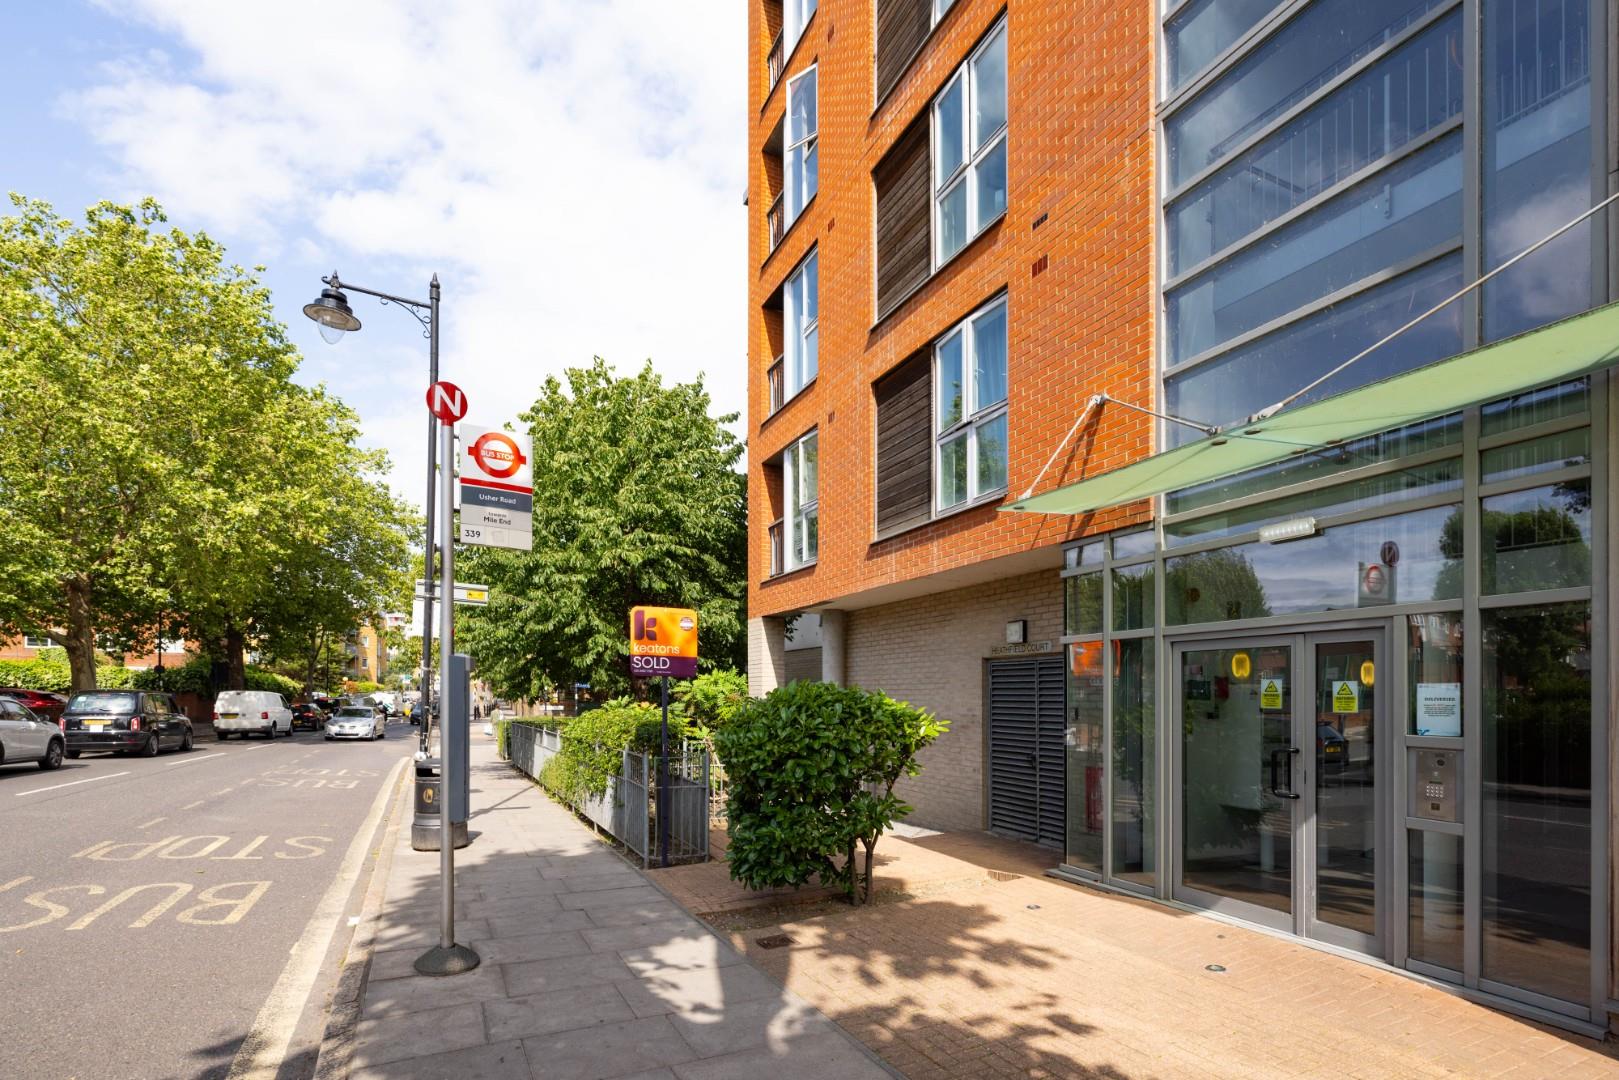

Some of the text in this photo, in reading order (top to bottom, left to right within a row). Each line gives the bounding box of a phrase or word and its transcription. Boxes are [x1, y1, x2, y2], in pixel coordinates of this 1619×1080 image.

[434, 384, 462, 417] N
[481, 450, 515, 461] BUS STOP
[483, 516, 512, 526] Mile End
[465, 529, 481, 538] 339
[633, 644, 680, 654] keatons
[1027, 642, 1049, 652] COURT
[632, 656, 670, 669] SOLD
[87, 835, 334, 861] STOP
[0, 880, 273, 933] BUS
